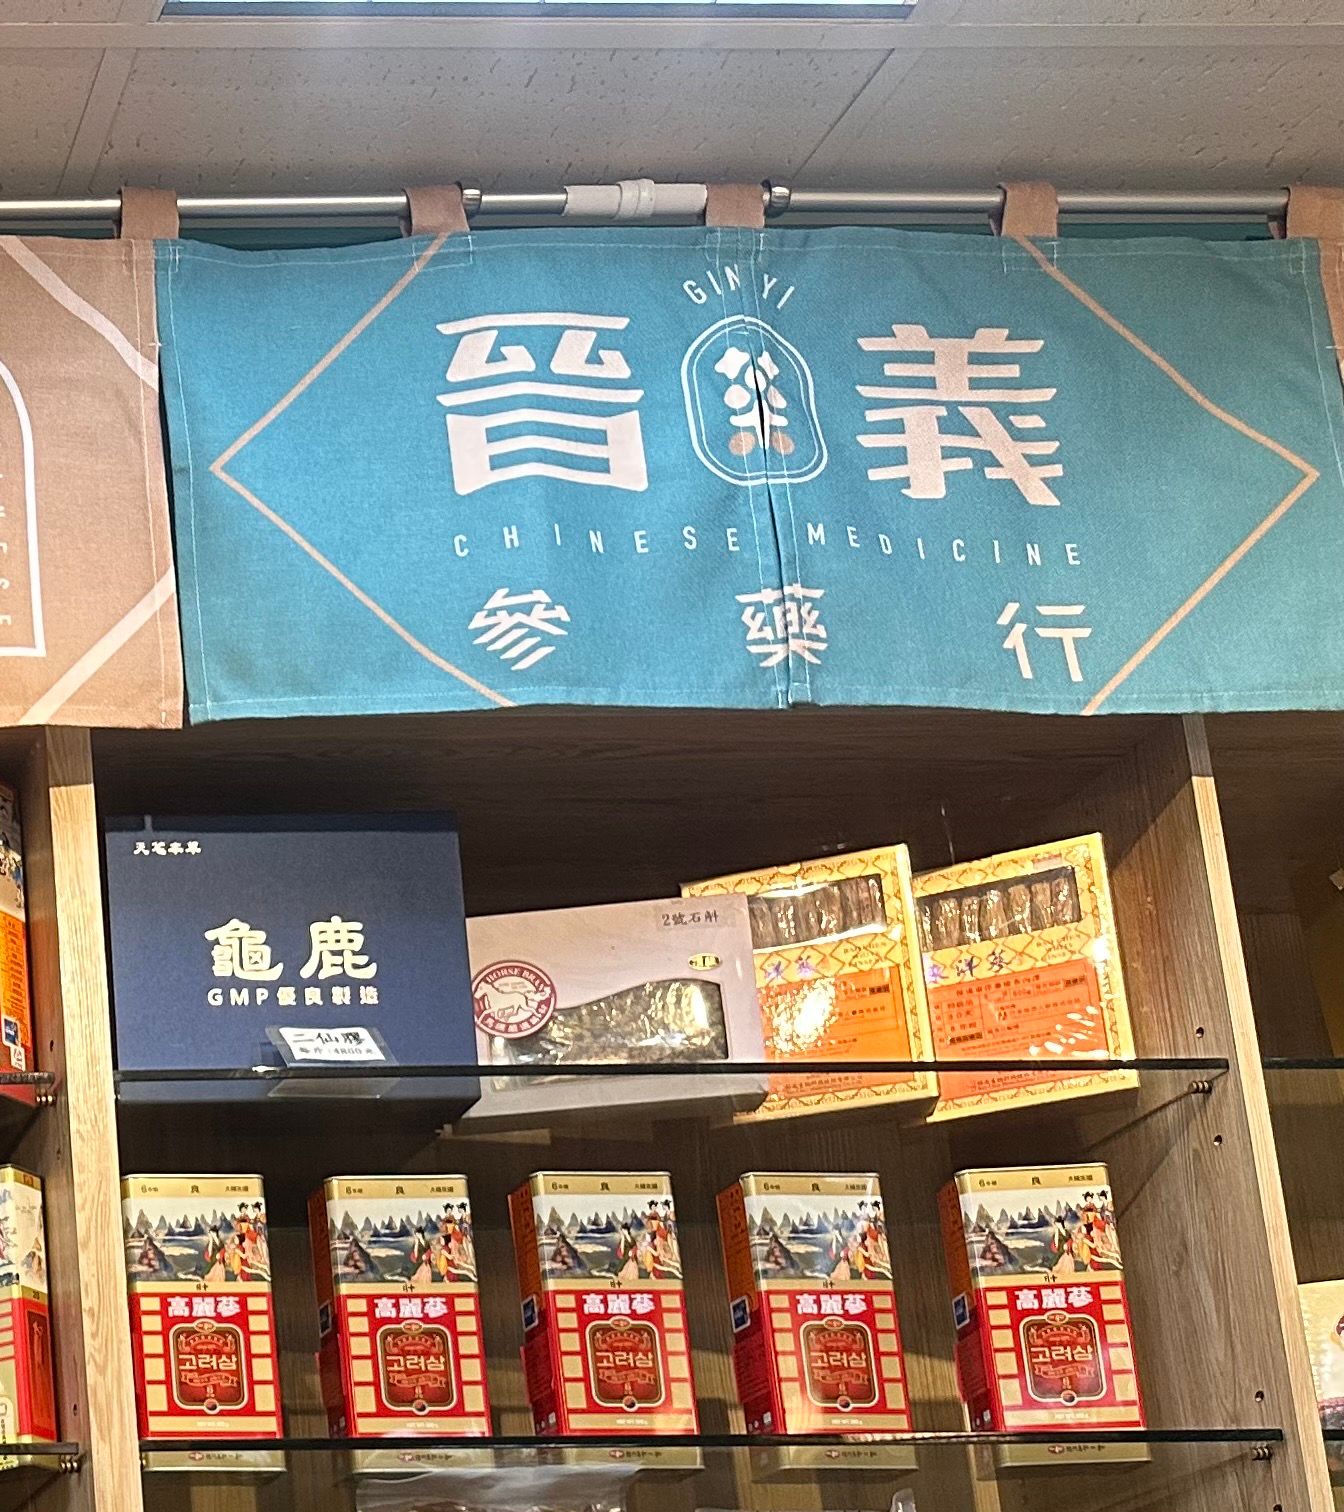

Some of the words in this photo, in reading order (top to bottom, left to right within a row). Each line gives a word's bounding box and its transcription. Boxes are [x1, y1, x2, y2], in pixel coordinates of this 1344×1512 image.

[682, 265, 742, 305] GIN
[761, 272, 796, 310] YI
[436, 312, 649, 496] 晉
[856, 324, 1064, 506] 義
[453, 523, 742, 558] CHINESE
[806, 522, 1083, 566] MEDICINE
[205, 914, 377, 981] 龜鹿
[485, 968, 520, 983] HORSE
[167, 1296, 240, 1317] 高麗蔘
[375, 1297, 448, 1318] 高麗蔘
[582, 1292, 653, 1315] 高麗蔘
[796, 1292, 868, 1315] 高麗蔘
[1014, 1286, 1093, 1310] 高麗蔘
[178, 1353, 237, 1371] 고려삼
[387, 1354, 445, 1371] 고려삼
[596, 1352, 653, 1370] 고려삼
[811, 1350, 867, 1368] 고려삼
[1030, 1345, 1093, 1363] 고려삼
